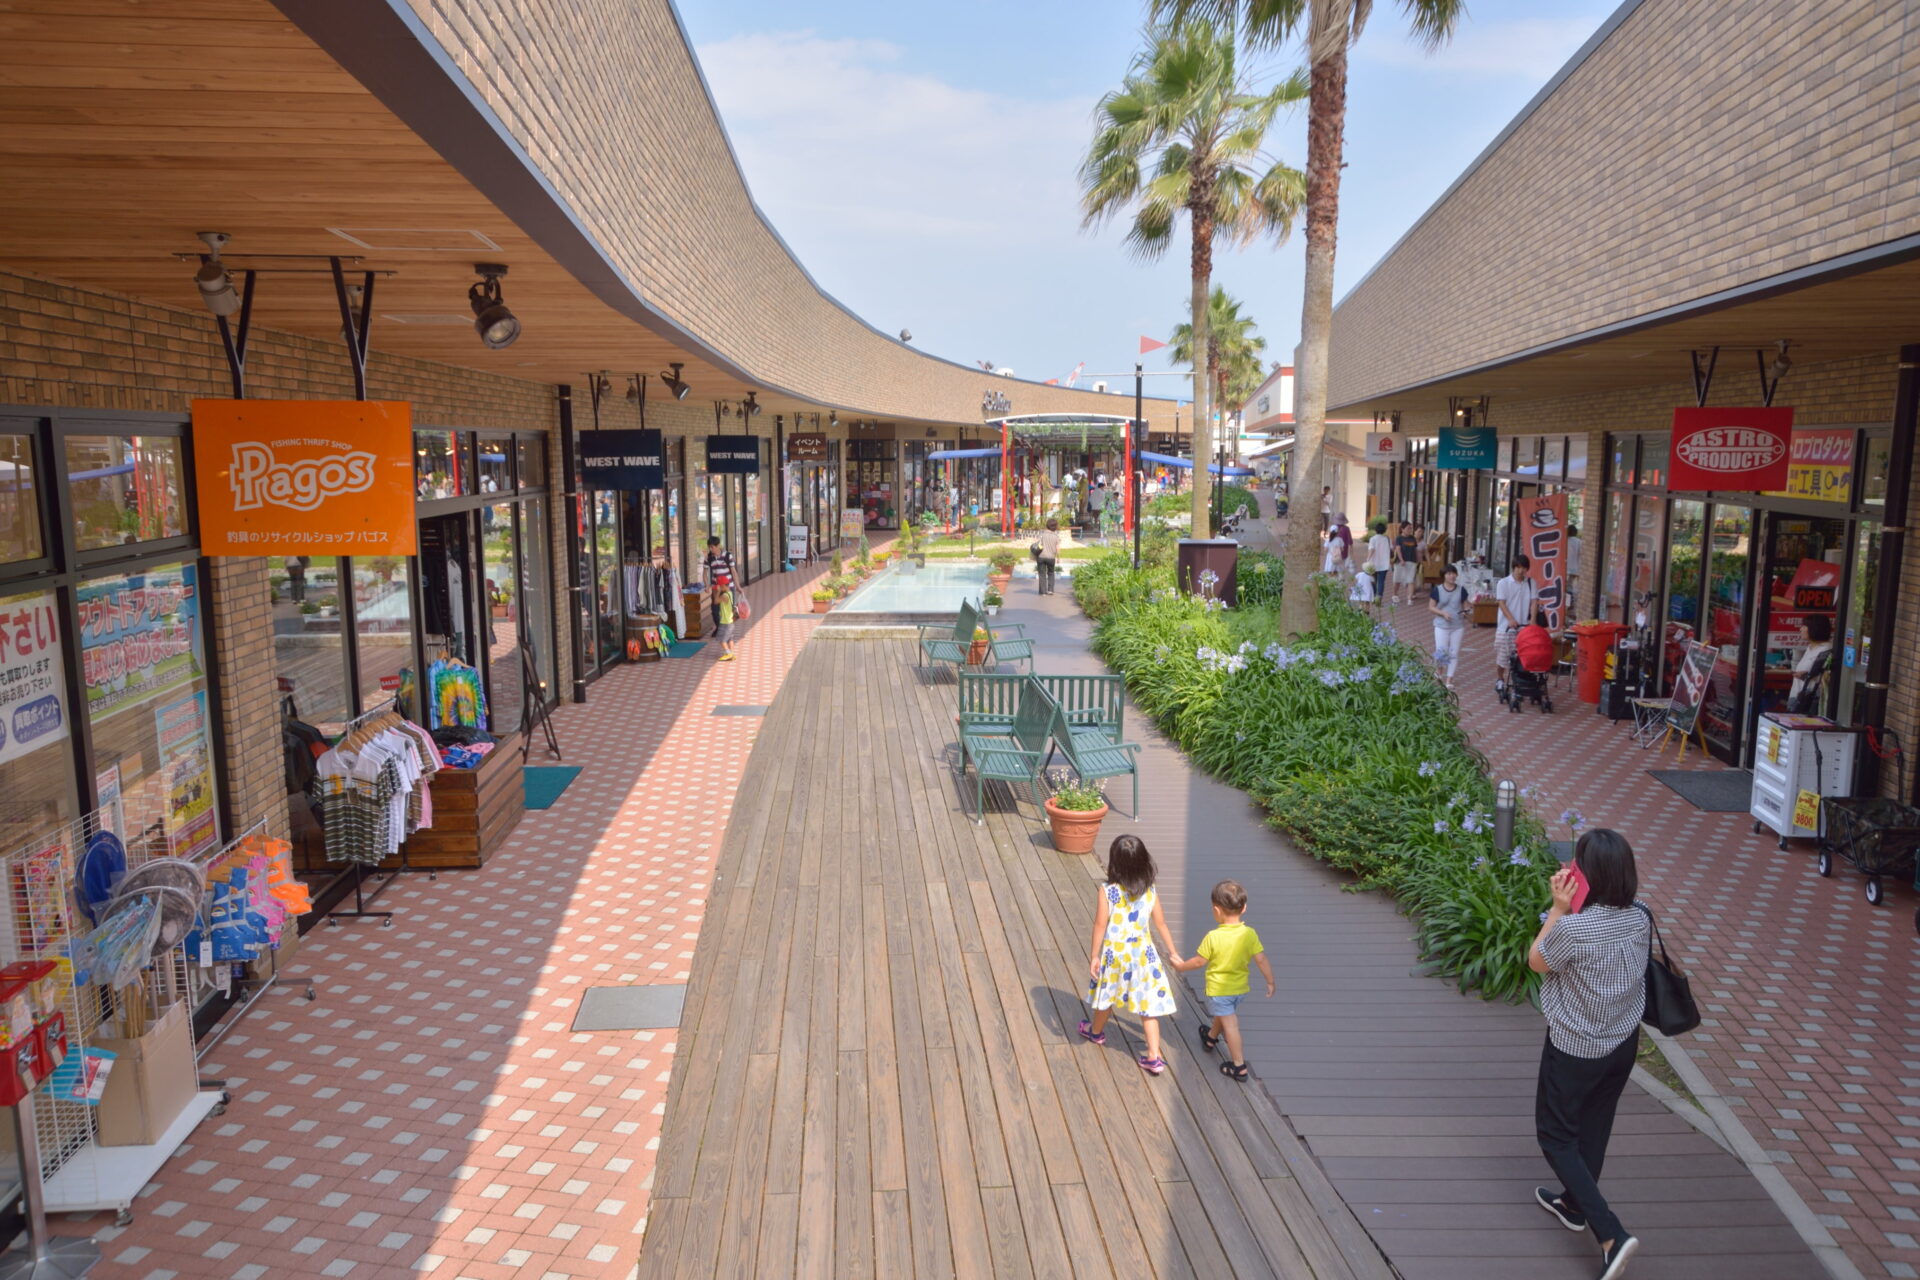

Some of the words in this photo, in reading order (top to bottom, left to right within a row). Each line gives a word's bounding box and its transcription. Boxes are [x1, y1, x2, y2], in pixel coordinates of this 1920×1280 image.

[271, 438, 301, 448] FISHING
[303, 438, 330, 447] THRIFT
[332, 441, 353, 450] SHOP
[1691, 429, 1774, 446] ASTRO
[1790, 436, 1853, 461] ロプロダクツ
[584, 457, 620, 467] WEST
[623, 456, 660, 466] WAVE
[1688, 452, 1773, 469] PRODUCTS
[234, 445, 373, 508] Pagos
[227, 531, 354, 543] 釣具のリサイクルショップ
[357, 531, 388, 542] パゴス
[1798, 590, 1831, 607] OPEN
